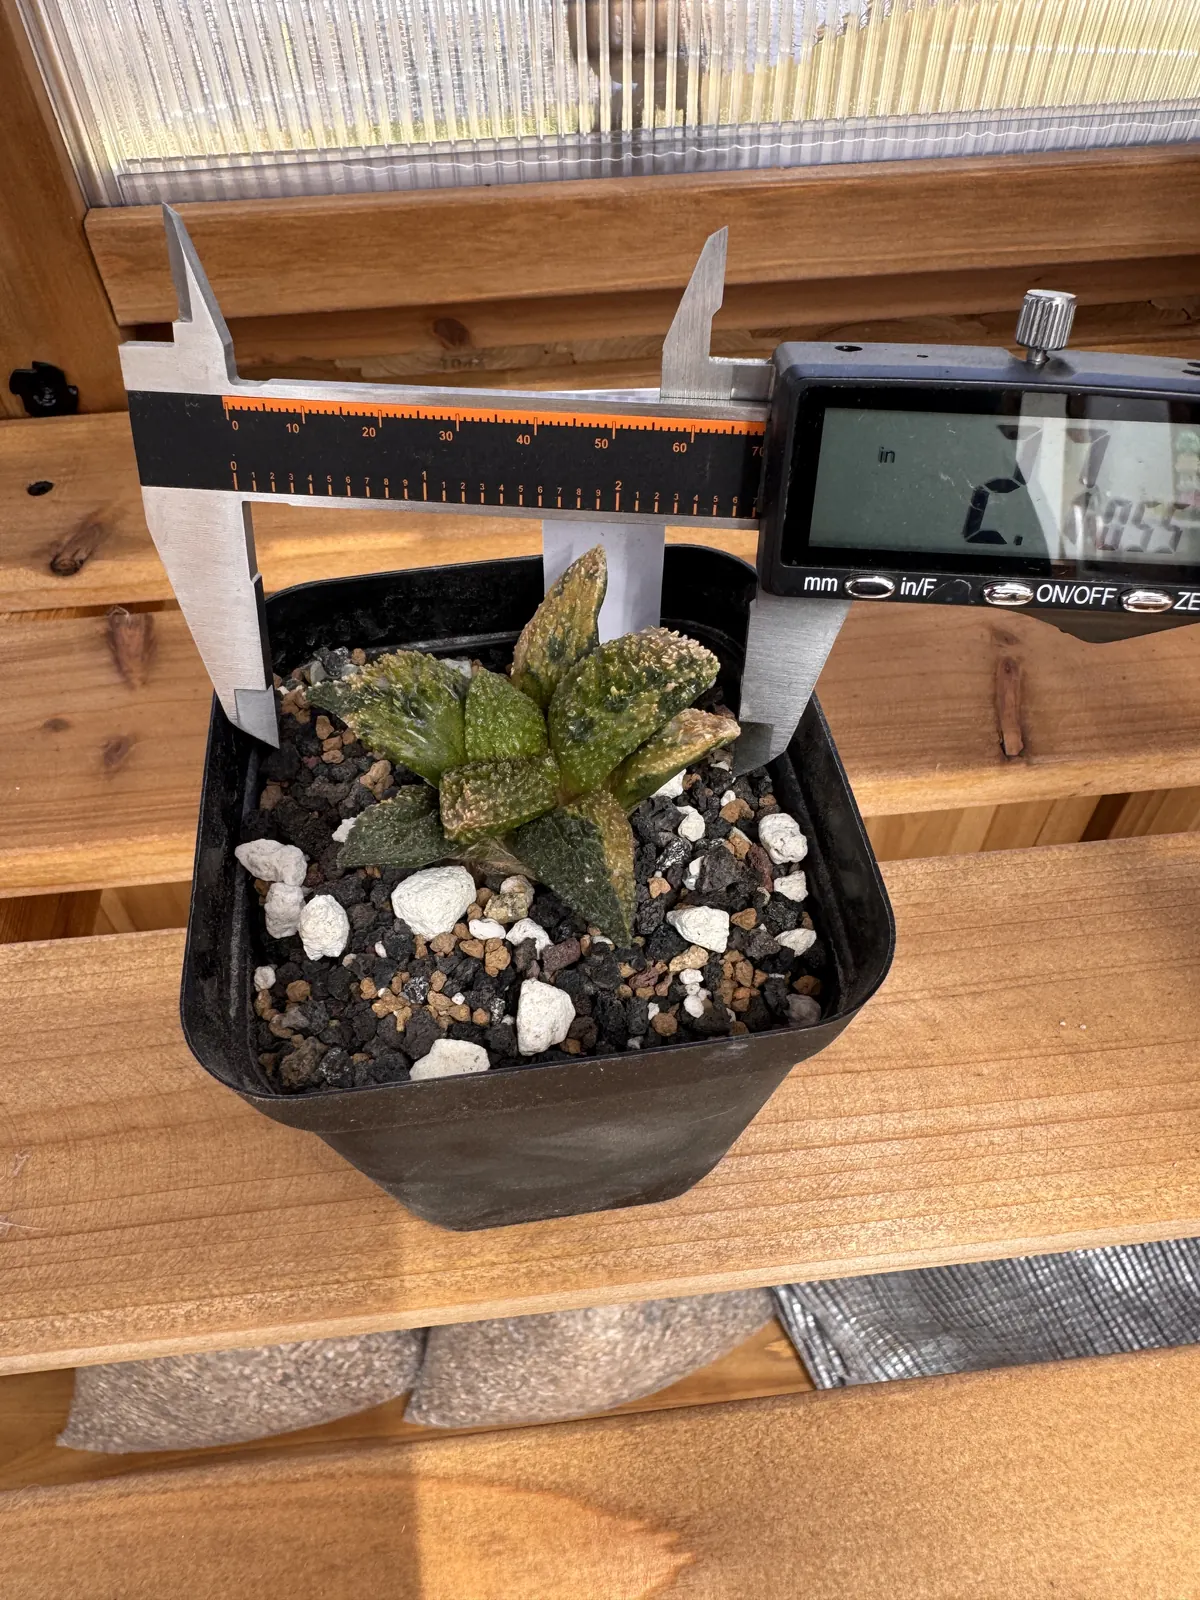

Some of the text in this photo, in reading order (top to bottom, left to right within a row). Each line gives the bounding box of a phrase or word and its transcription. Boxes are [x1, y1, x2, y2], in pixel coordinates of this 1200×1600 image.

[232, 421, 239, 431] 0
[286, 424, 299, 433] 10
[362, 427, 376, 437] 20
[439, 431, 453, 441] 30
[516, 435, 531, 445] 40
[595, 439, 608, 449] 50
[673, 443, 687, 453] 60
[878, 447, 896, 463] in
[230, 461, 237, 471] 0
[384, 478, 389, 486] 8
[422, 471, 427, 480] 1
[480, 483, 485, 491] 3
[596, 489, 601, 497] 9
[615, 481, 622, 490] 2
[654, 492, 660, 500] 2
[674, 493, 679, 501] 3
[713, 495, 718, 503] 5
[732, 496, 738, 504] 6
[804, 577, 838, 592] mm
[900, 578, 937, 596] in/F
[1037, 585, 1118, 606] ON/OFF
